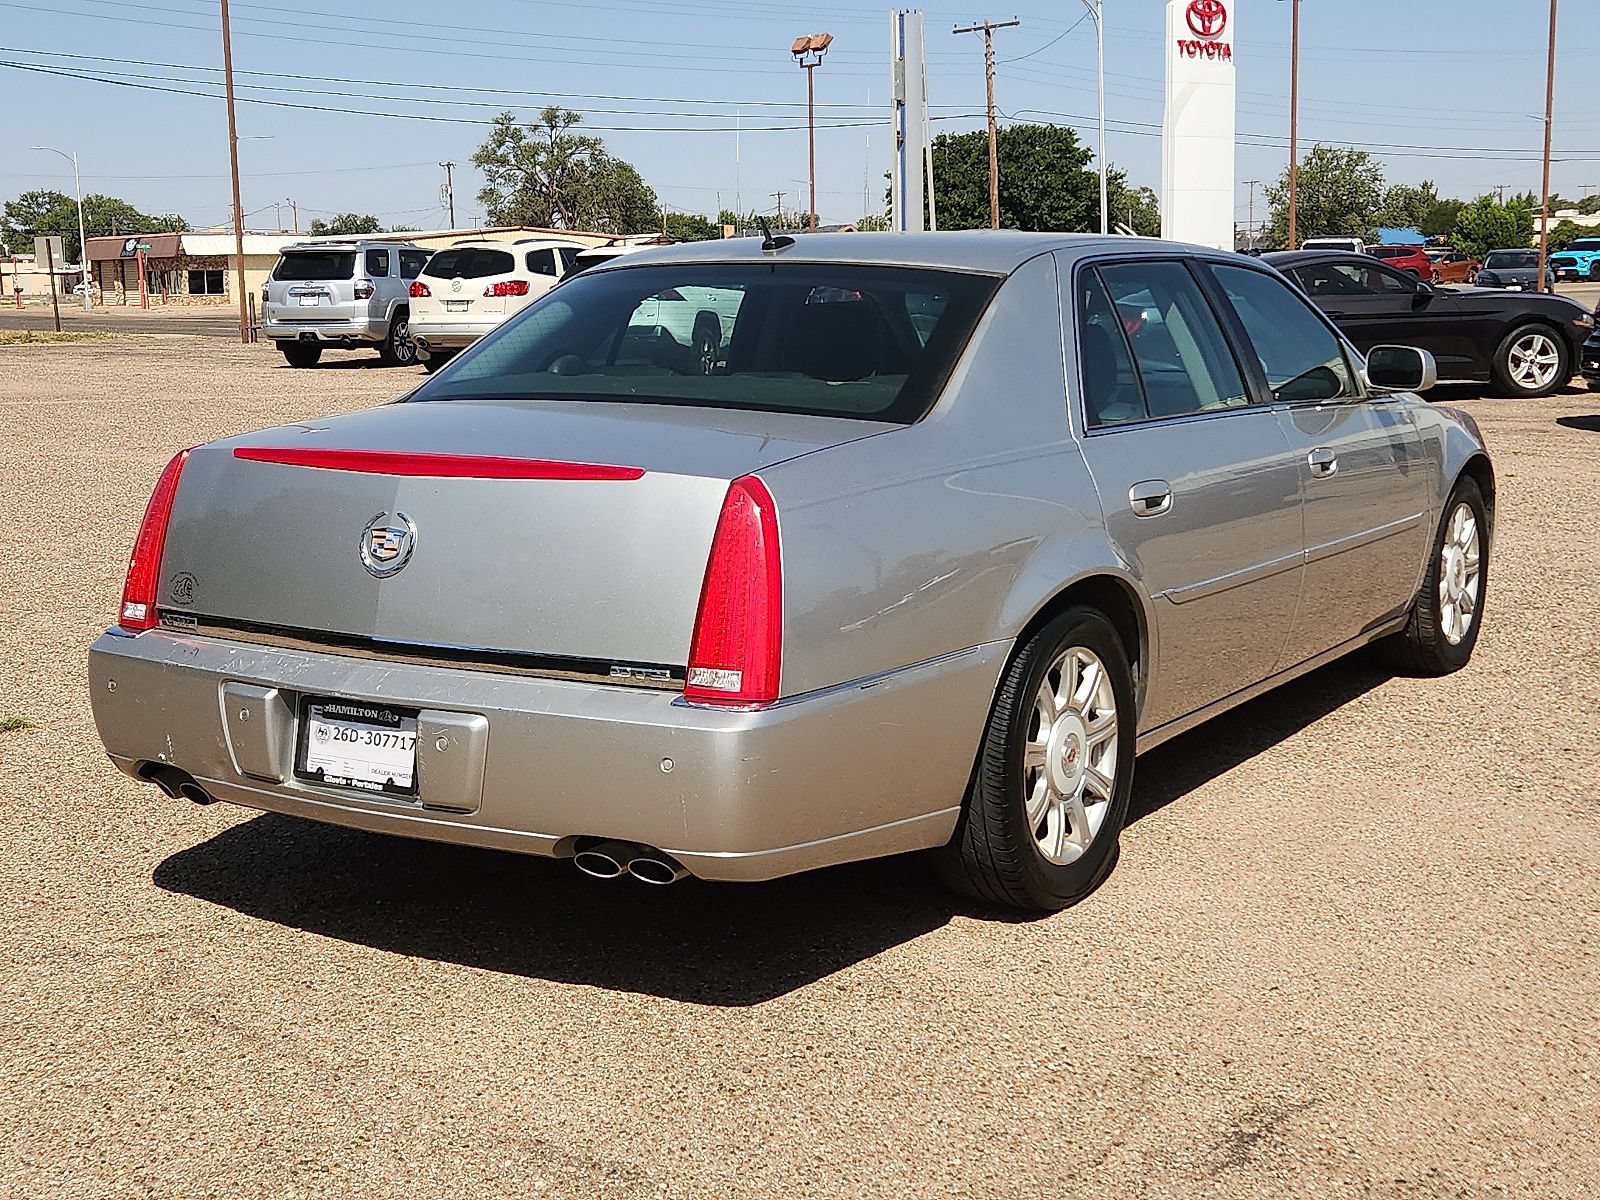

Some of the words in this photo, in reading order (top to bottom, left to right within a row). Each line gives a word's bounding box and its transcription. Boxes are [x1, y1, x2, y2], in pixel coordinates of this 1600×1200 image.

[1177, 39, 1232, 60] TOYOTA
[329, 704, 378, 719] HAMILTON
[333, 727, 416, 751] 26D-307717
